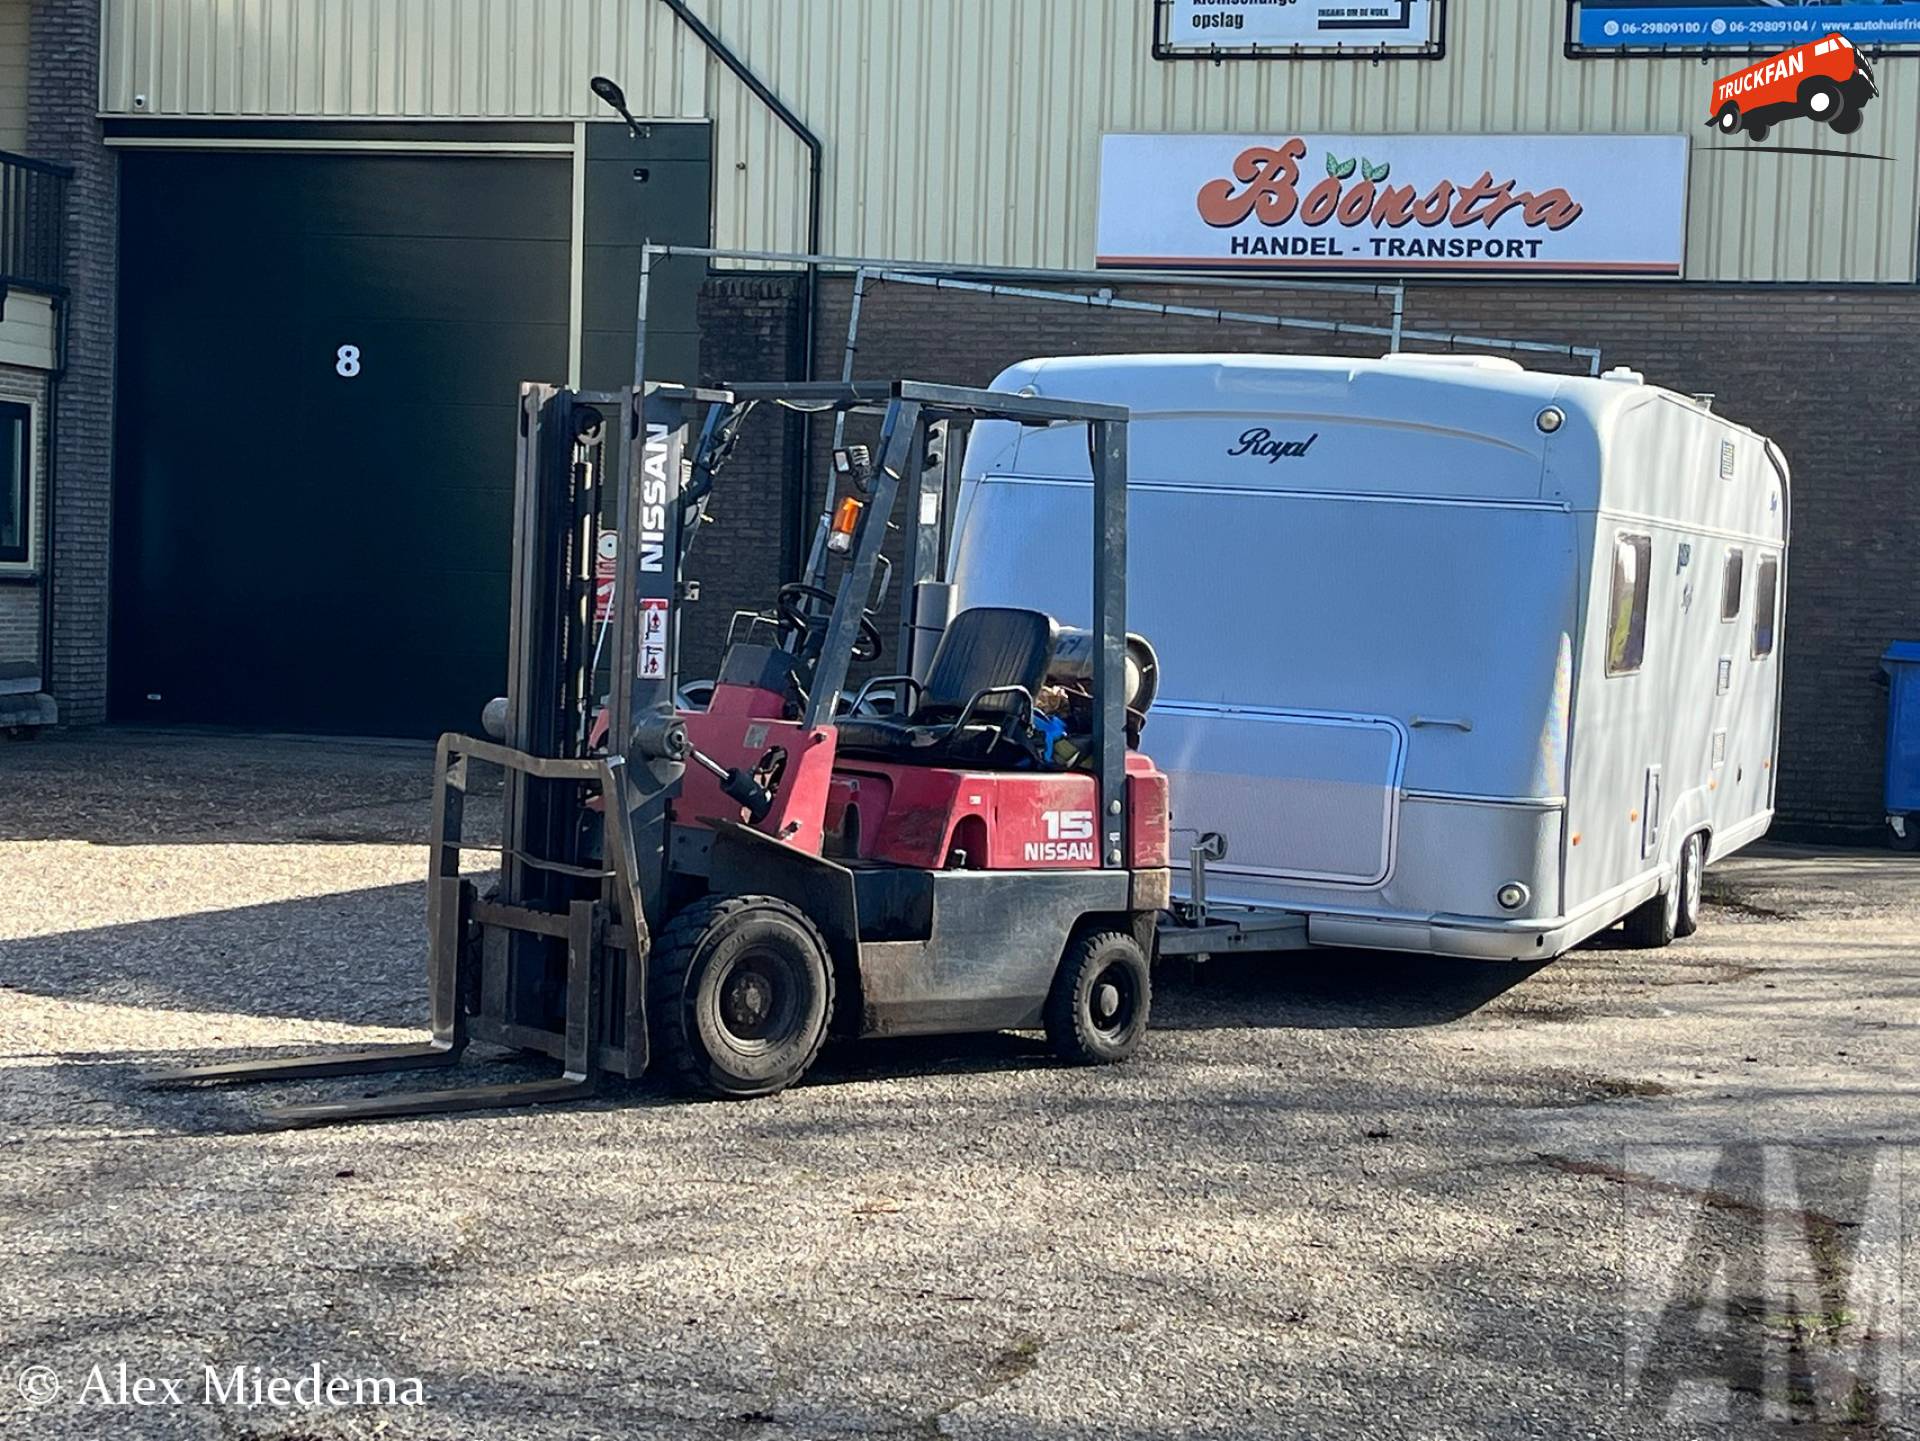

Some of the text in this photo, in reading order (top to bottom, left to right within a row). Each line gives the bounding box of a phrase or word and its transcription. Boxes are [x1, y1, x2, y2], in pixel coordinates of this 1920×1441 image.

[1192, 12, 1244, 29] opslag
[1622, 22, 1700, 34] 06-29809100
[1730, 20, 1809, 32] 06-29809104
[1231, 237, 1343, 256] HANDEL
[1369, 238, 1543, 258] TRANSPORT
[336, 344, 361, 377] 8
[1227, 427, 1318, 464] Royal
[640, 423, 669, 573] NISSAN
[1041, 810, 1093, 840] 15
[1025, 842, 1093, 861] NISSAN
